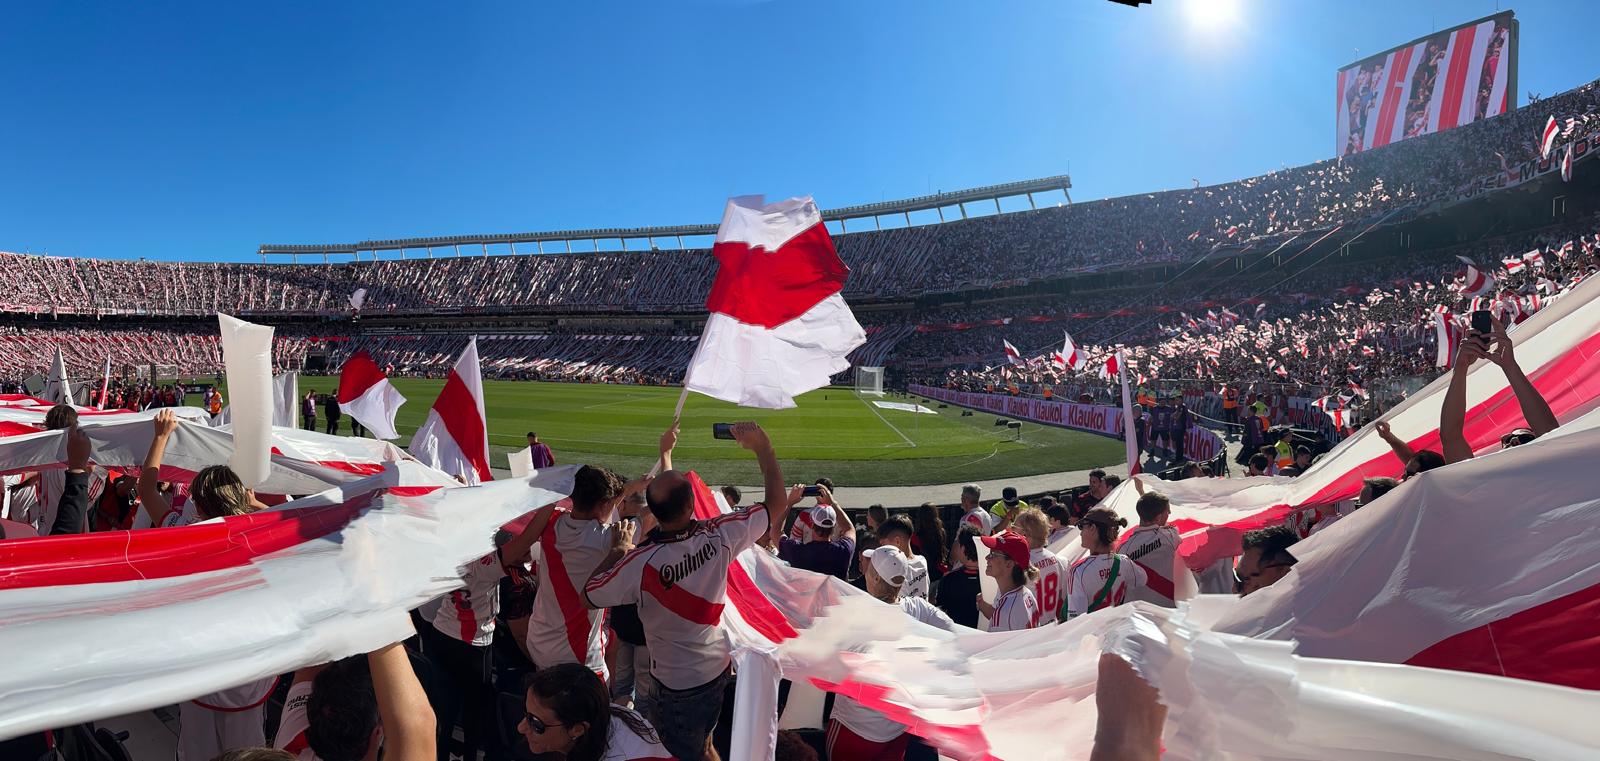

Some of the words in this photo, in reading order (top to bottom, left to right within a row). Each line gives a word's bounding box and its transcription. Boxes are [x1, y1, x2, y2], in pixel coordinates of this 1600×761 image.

[1034, 399, 1062, 423] Klaukol
[1069, 404, 1107, 431] Klaukol
[1183, 431, 1215, 461] aukol
[660, 540, 717, 591] Quilmes
[1033, 556, 1058, 569] MARTINE
[1035, 571, 1059, 618] 18
